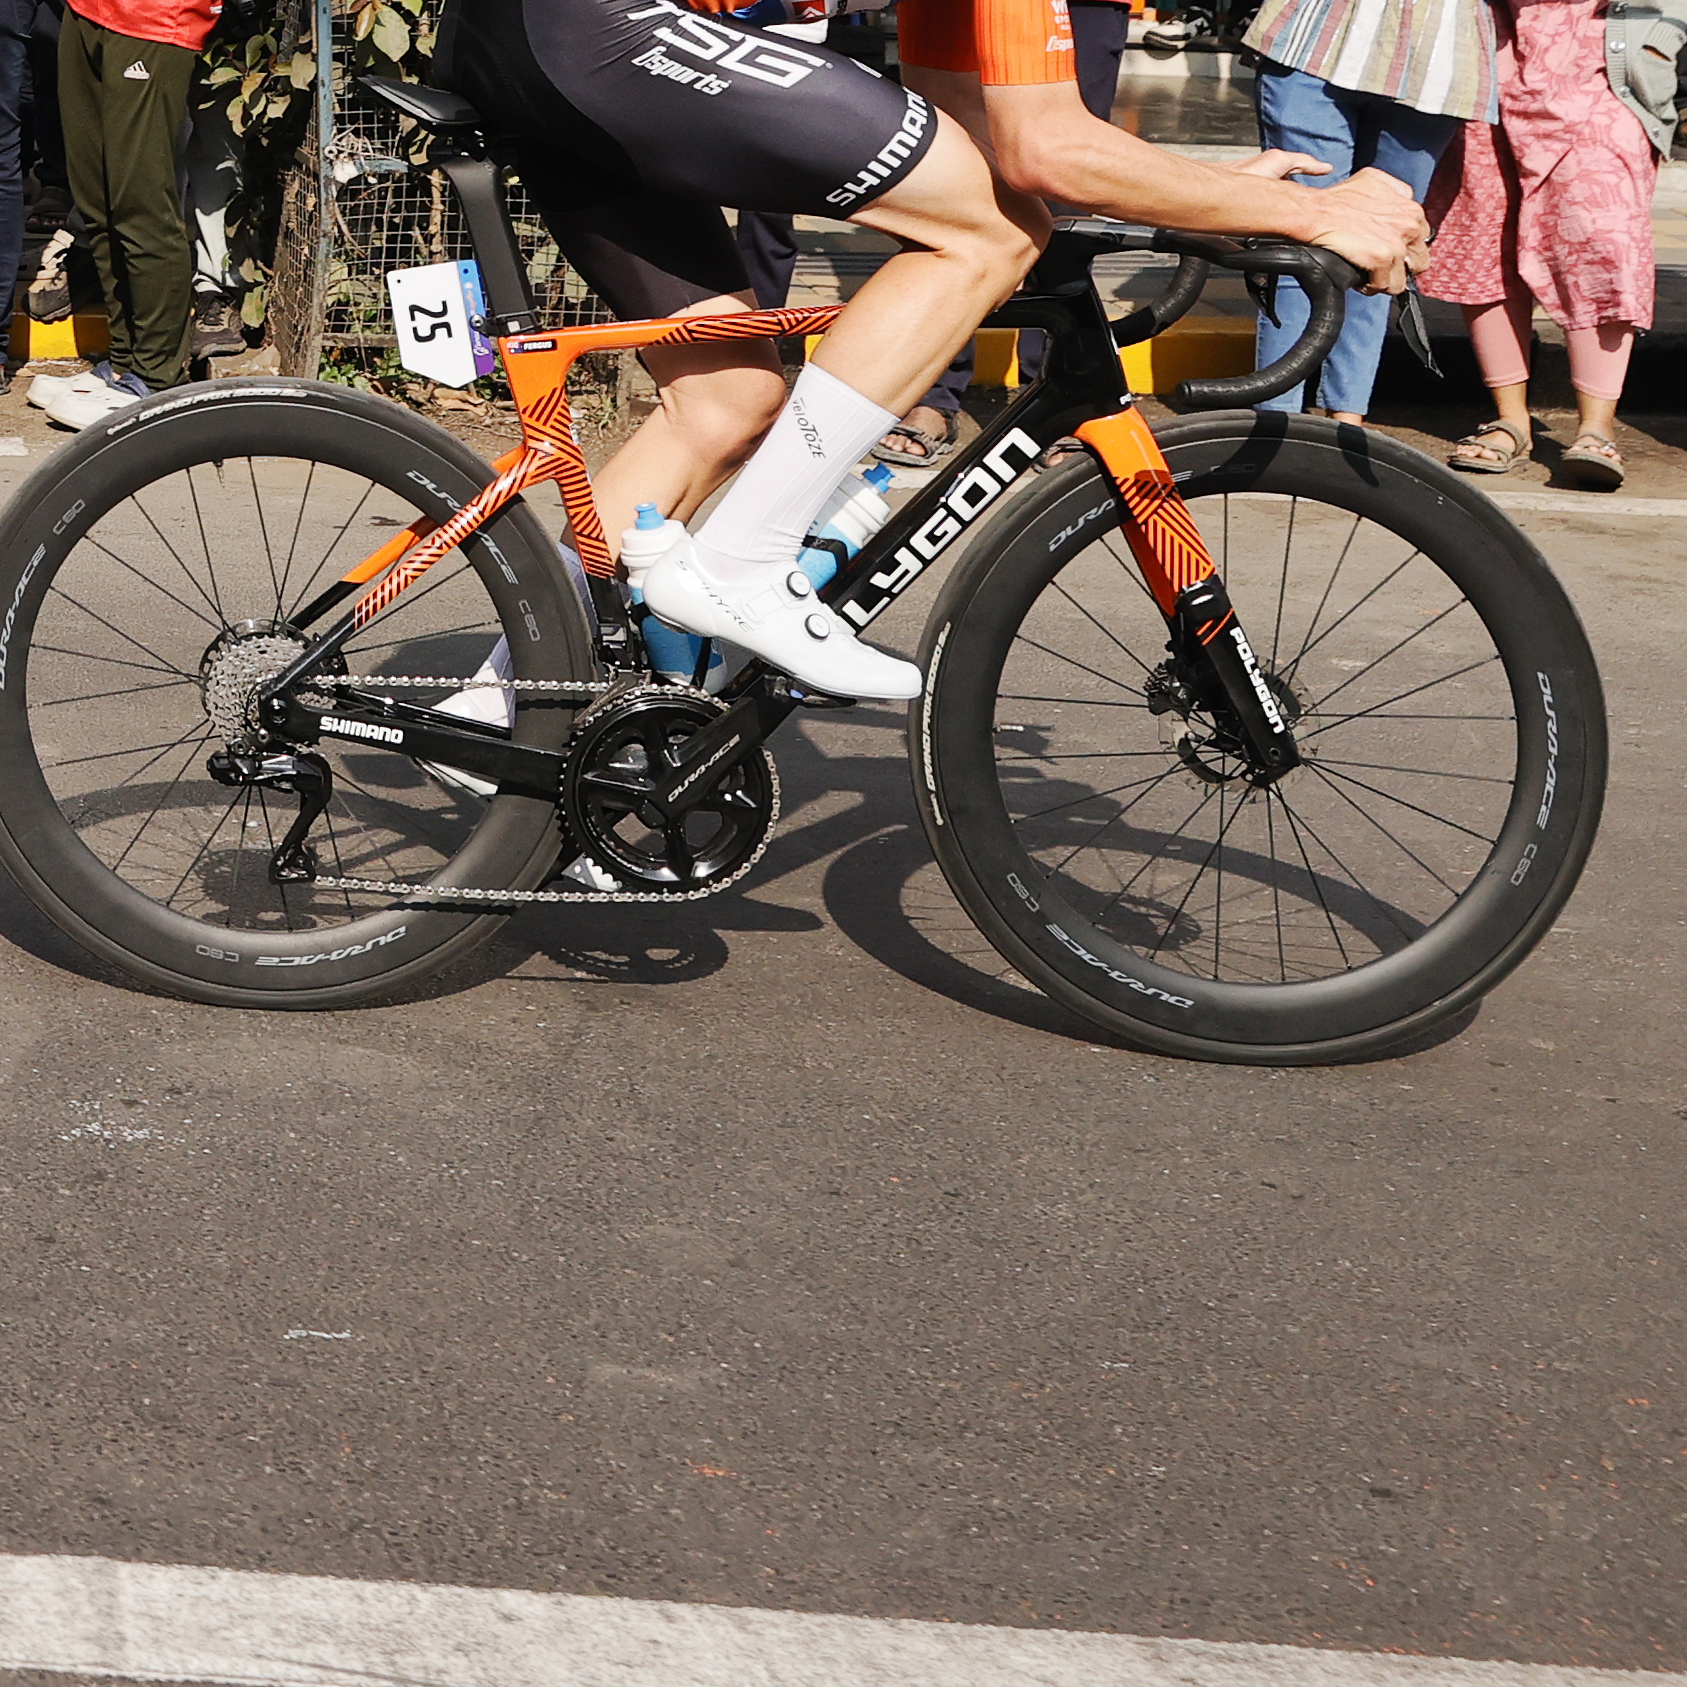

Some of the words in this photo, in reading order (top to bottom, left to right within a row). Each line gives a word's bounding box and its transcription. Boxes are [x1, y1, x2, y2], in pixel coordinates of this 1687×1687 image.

[407, 298, 454, 343] 25
[523, 341, 555, 350] FERGUS
[138, 395, 189, 420] GRAND
[188, 389, 233, 405] PRIX
[232, 388, 278, 398] 5000
[1229, 626, 1286, 733] POLYGON
[319, 716, 404, 745] SHIMANO
[1536, 671, 1561, 829] DURA-ACE
[667, 734, 741, 804] DURA-ACE
[254, 926, 407, 967] DURA-ACE
[1045, 923, 1196, 1009] DURA-ACE
